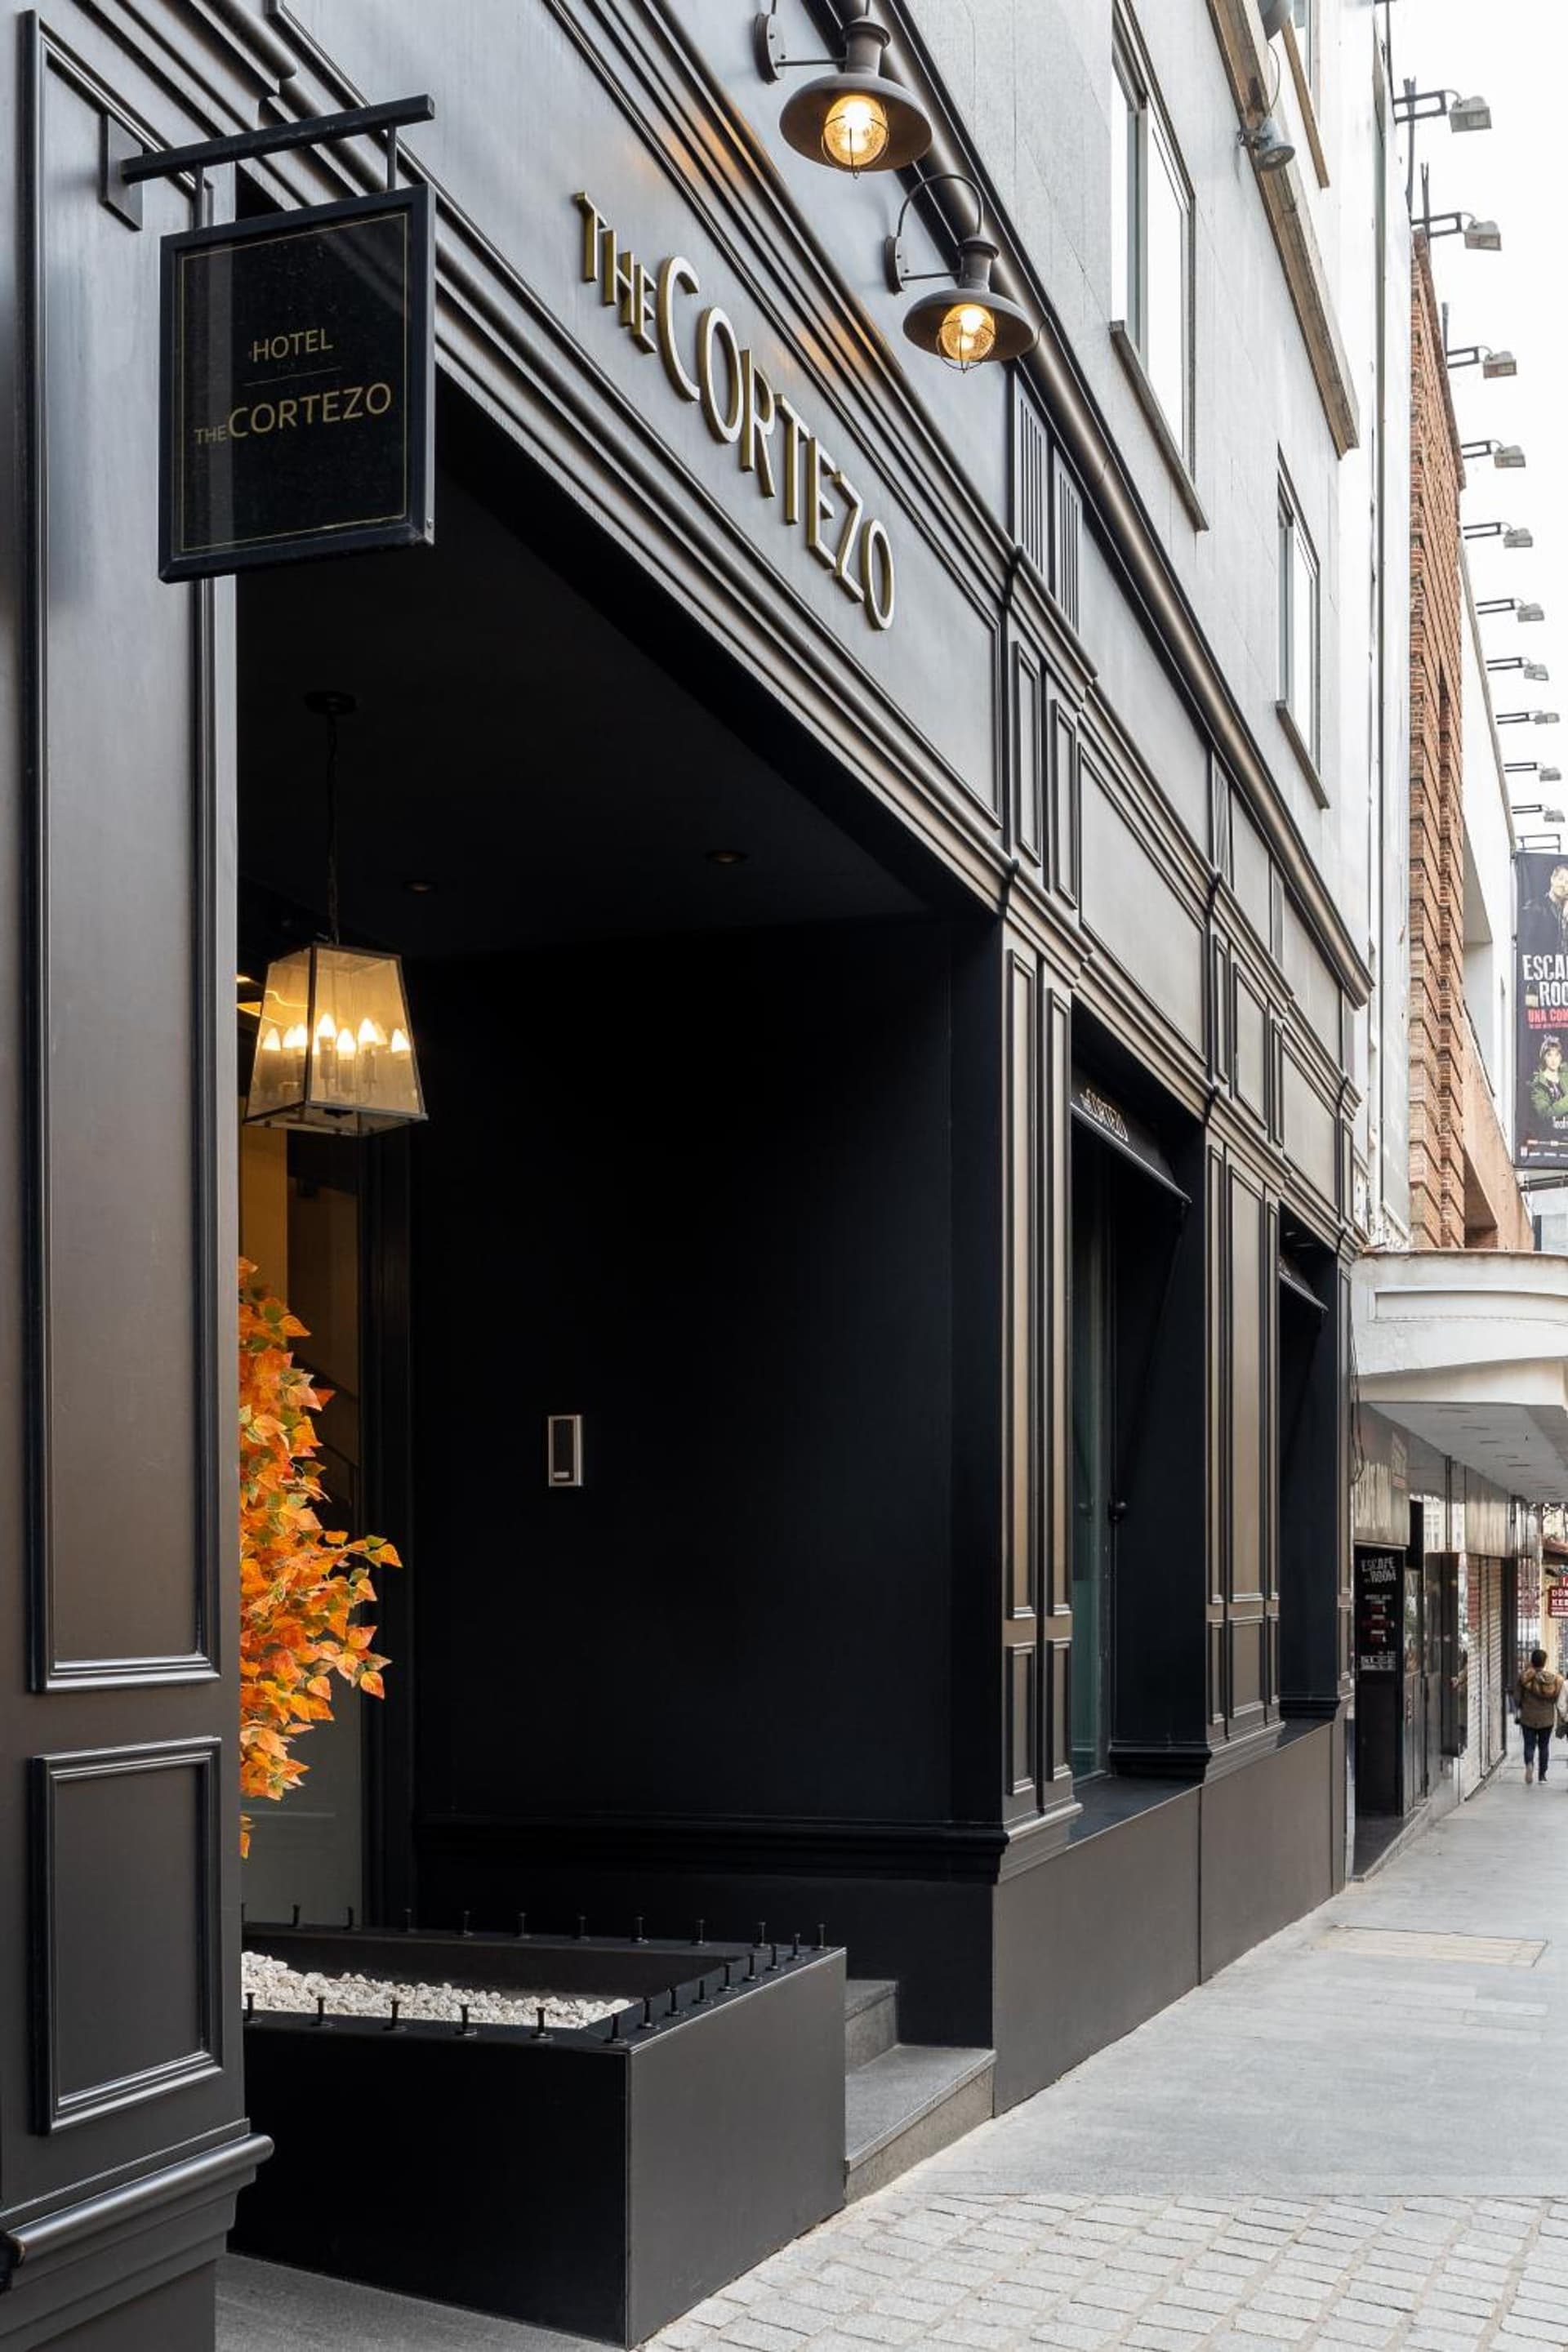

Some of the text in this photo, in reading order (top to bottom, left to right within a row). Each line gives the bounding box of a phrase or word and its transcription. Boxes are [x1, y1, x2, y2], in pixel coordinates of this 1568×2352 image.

[252, 328, 333, 362] HOTEL
[194, 383, 392, 445] THE CORTEZO
[577, 192, 895, 630] THE CORTEZO
[1522, 954, 1568, 981] ESCA
[1528, 1009, 1547, 1022] UNA
